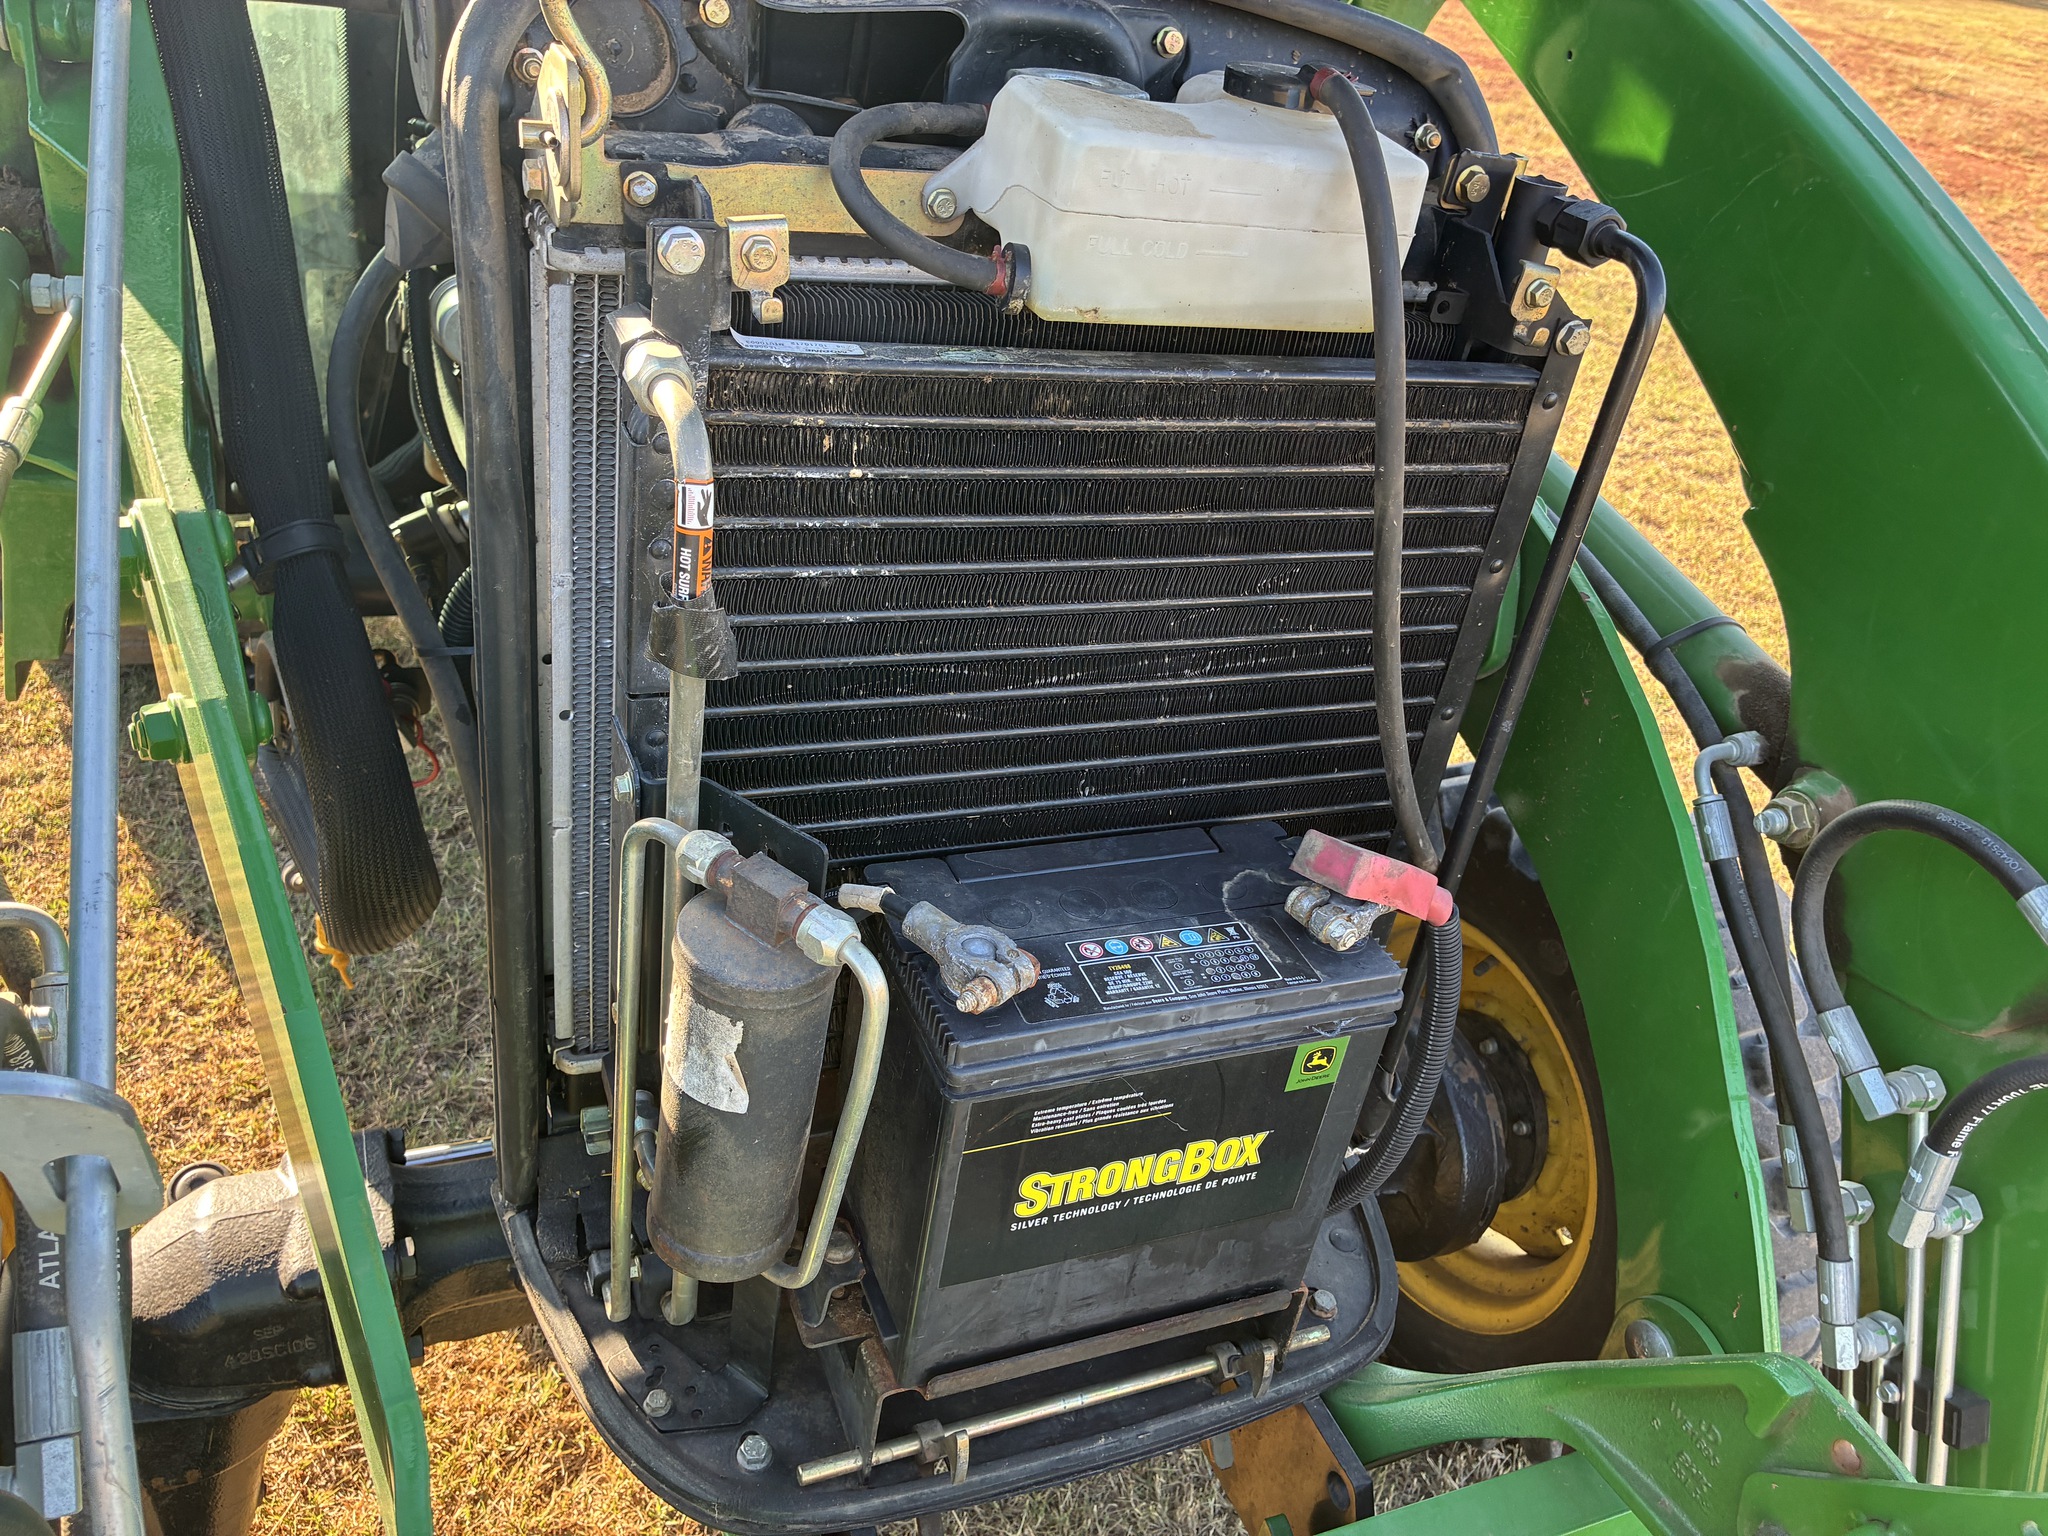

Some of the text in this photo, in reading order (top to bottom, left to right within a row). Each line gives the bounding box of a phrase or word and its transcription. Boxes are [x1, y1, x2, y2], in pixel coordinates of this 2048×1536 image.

[1086, 235, 1188, 260] FULL COLD
[680, 547, 692, 571] HOT
[1033, 1110, 1078, 1121] Maintenance-free
[1056, 1103, 1087, 1111] temperature
[1031, 1119, 1062, 1128] Extra-heavy
[1951, 1116, 1984, 1149] Flame
[1010, 1172, 1258, 1232] SILVER TECHNOLOGY / TECHNOLOGIE DE POINTE
